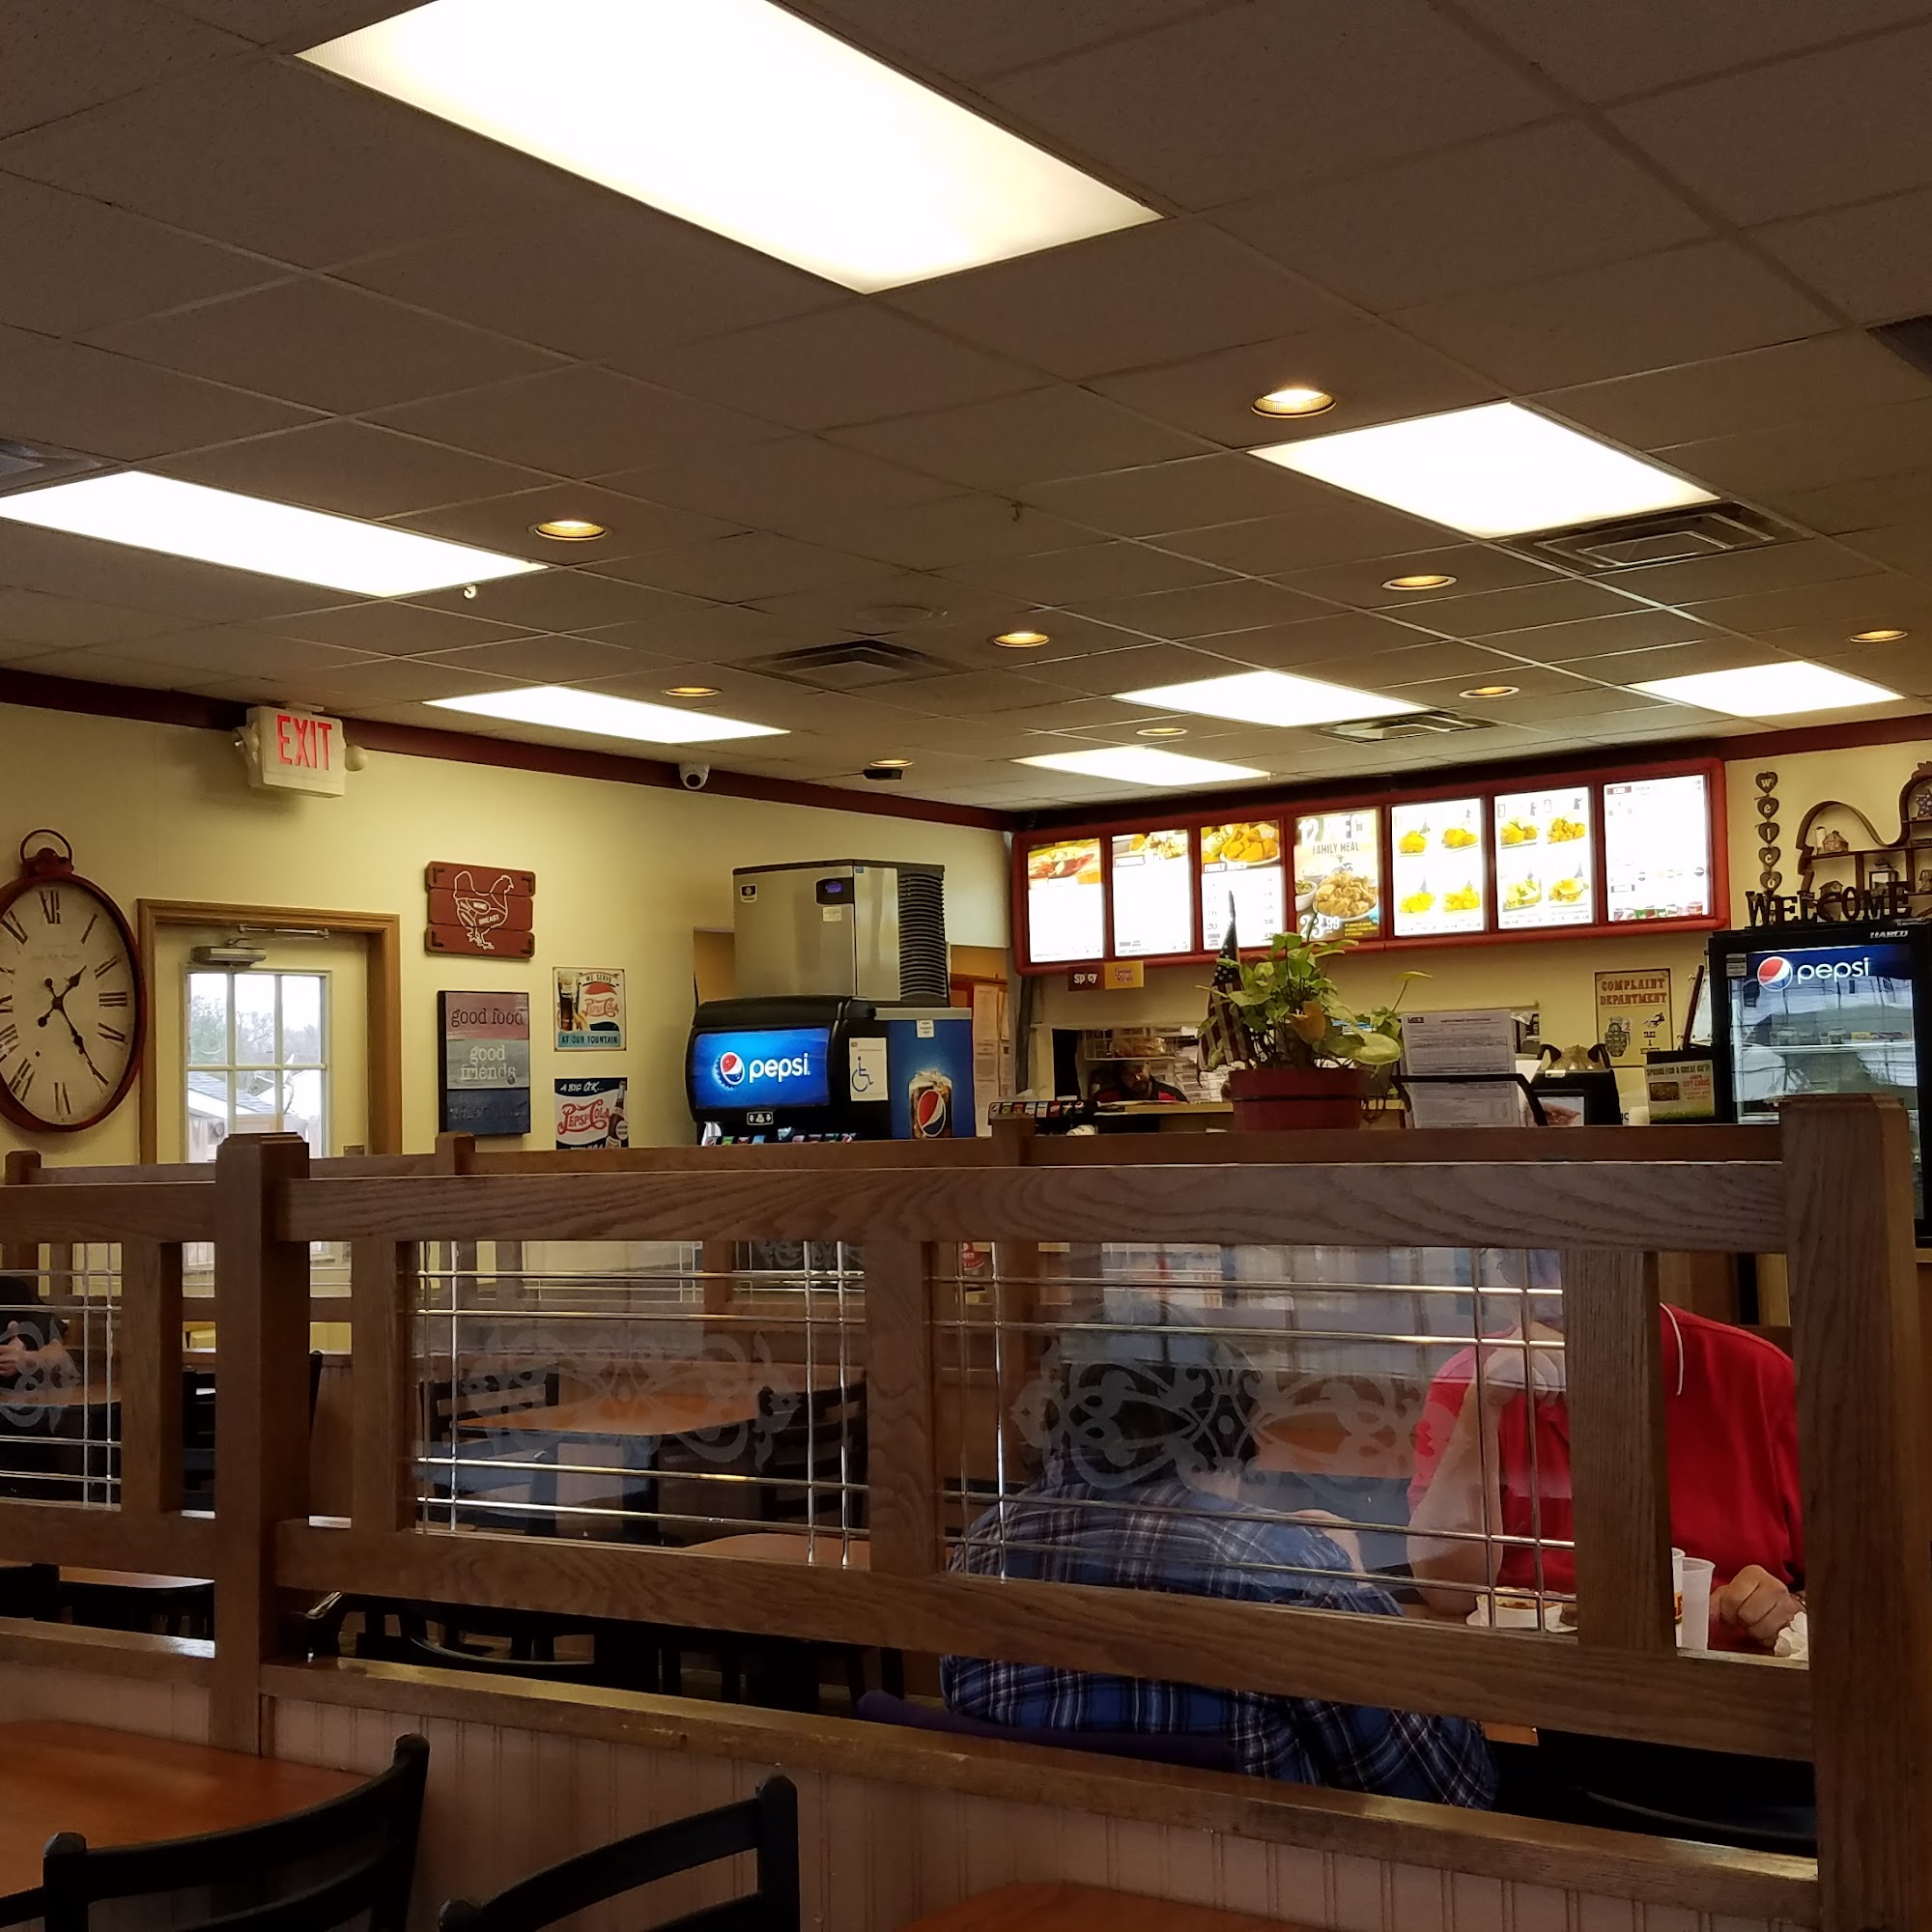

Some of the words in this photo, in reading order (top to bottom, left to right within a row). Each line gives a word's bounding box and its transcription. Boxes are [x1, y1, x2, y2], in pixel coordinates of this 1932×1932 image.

[276, 714, 332, 771] EXIT
[1298, 818, 1319, 847] 12
[1312, 843, 1338, 856] FAMILY
[1340, 840, 1359, 852] MEAL
[1746, 881, 1912, 928] WELCOME
[1073, 972, 1097, 984] Spcy
[1797, 957, 1870, 984] pepsi
[1601, 979, 1665, 992] COMPLAINT
[1600, 992, 1667, 1006] DEPARTMENT
[451, 1008, 487, 1028] good
[492, 1008, 525, 1026] food
[561, 1036, 569, 1044] AT
[573, 1036, 584, 1044] OUR
[587, 1036, 618, 1044] FOUNTAIN
[469, 1044, 505, 1065] good
[460, 1063, 516, 1081] friends
[749, 1052, 810, 1084] pepsi
[560, 1083, 567, 1092] A
[568, 1083, 582, 1093] BIG
